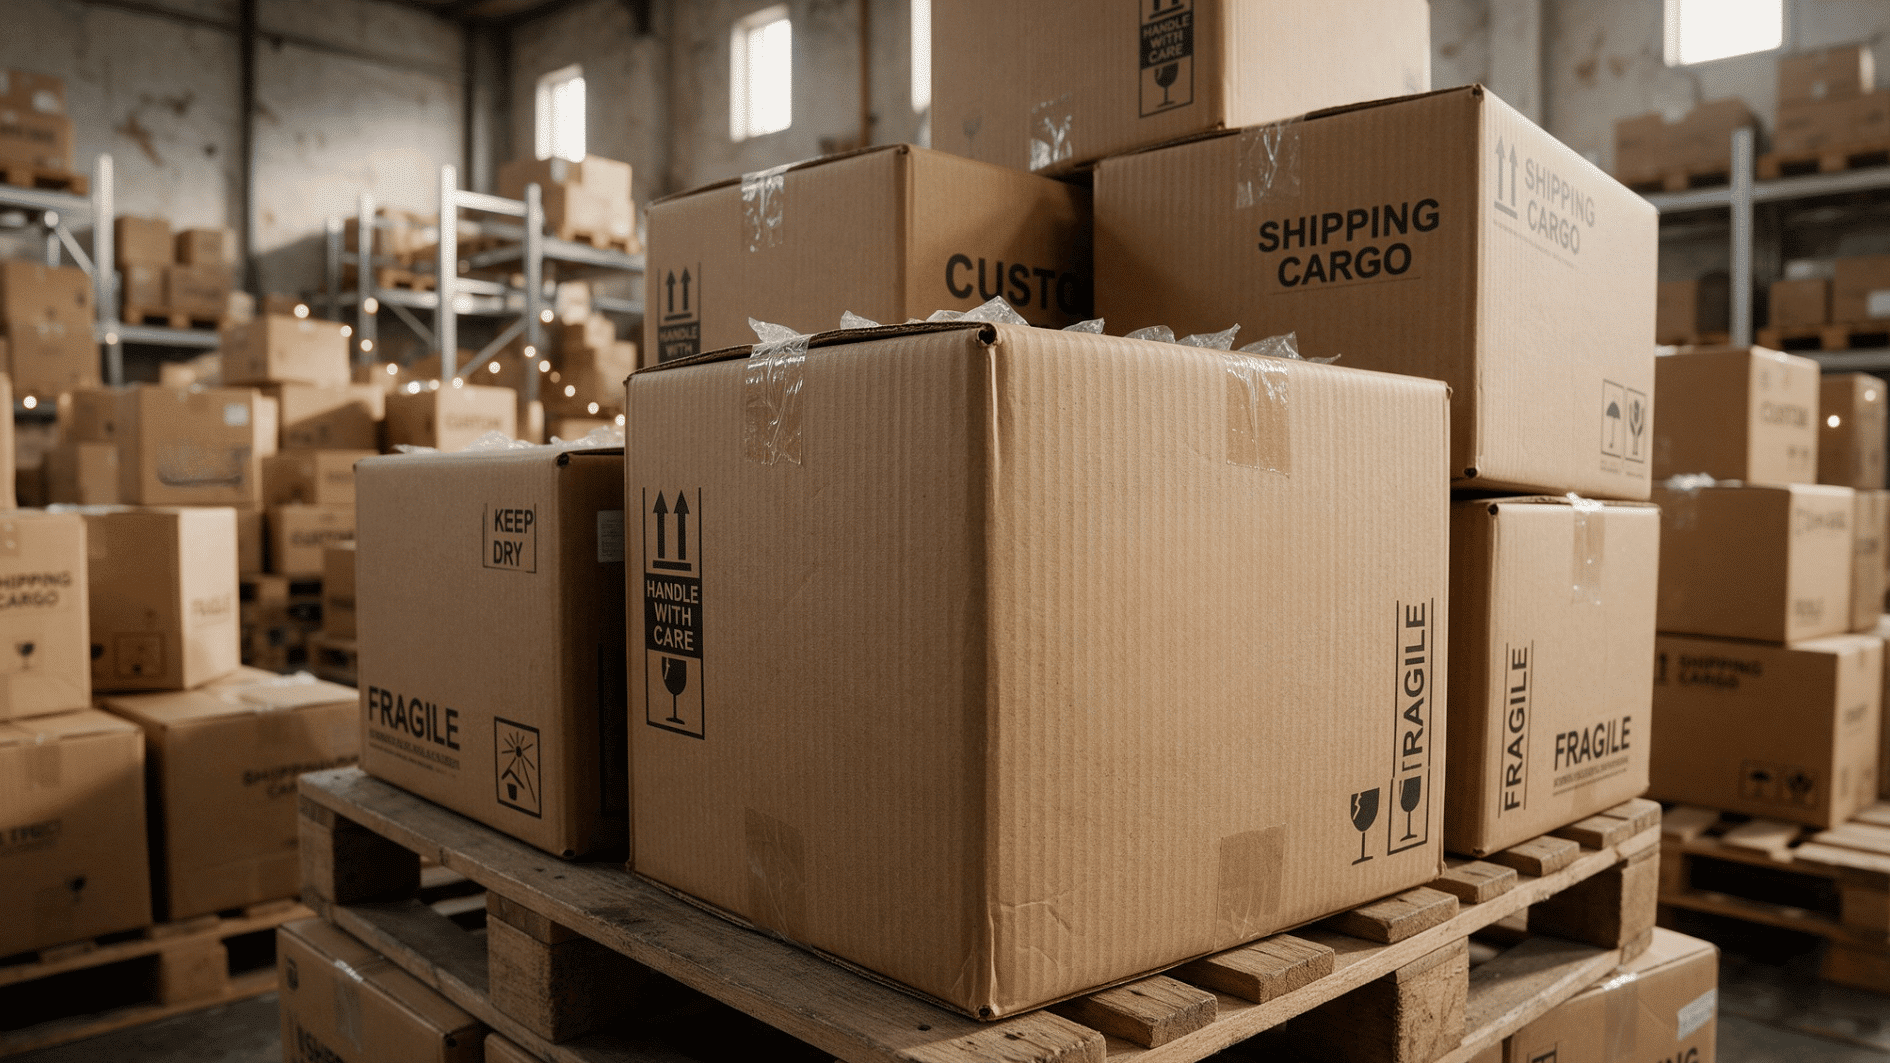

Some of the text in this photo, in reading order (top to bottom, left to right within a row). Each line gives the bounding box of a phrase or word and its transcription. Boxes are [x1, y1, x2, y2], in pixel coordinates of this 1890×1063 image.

[1142, 14, 1190, 38] HANDLE
[1150, 30, 1184, 49] WITH
[1148, 42, 1184, 64] CARE
[1525, 158, 1595, 228] SHIPPING
[1258, 198, 1440, 253] SHIPPING
[1527, 199, 1580, 256] CARGO
[1277, 242, 1412, 288] CARGO
[494, 508, 534, 534] KEEP
[493, 540, 523, 567] DRY
[646, 580, 699, 605] HANDLE
[654, 601, 692, 627] WITH
[653, 624, 695, 652] CARE
[368, 685, 461, 752] FRAGILE
[1504, 647, 1528, 812] FRAGILE
[1554, 715, 1632, 772] FRAGILE
